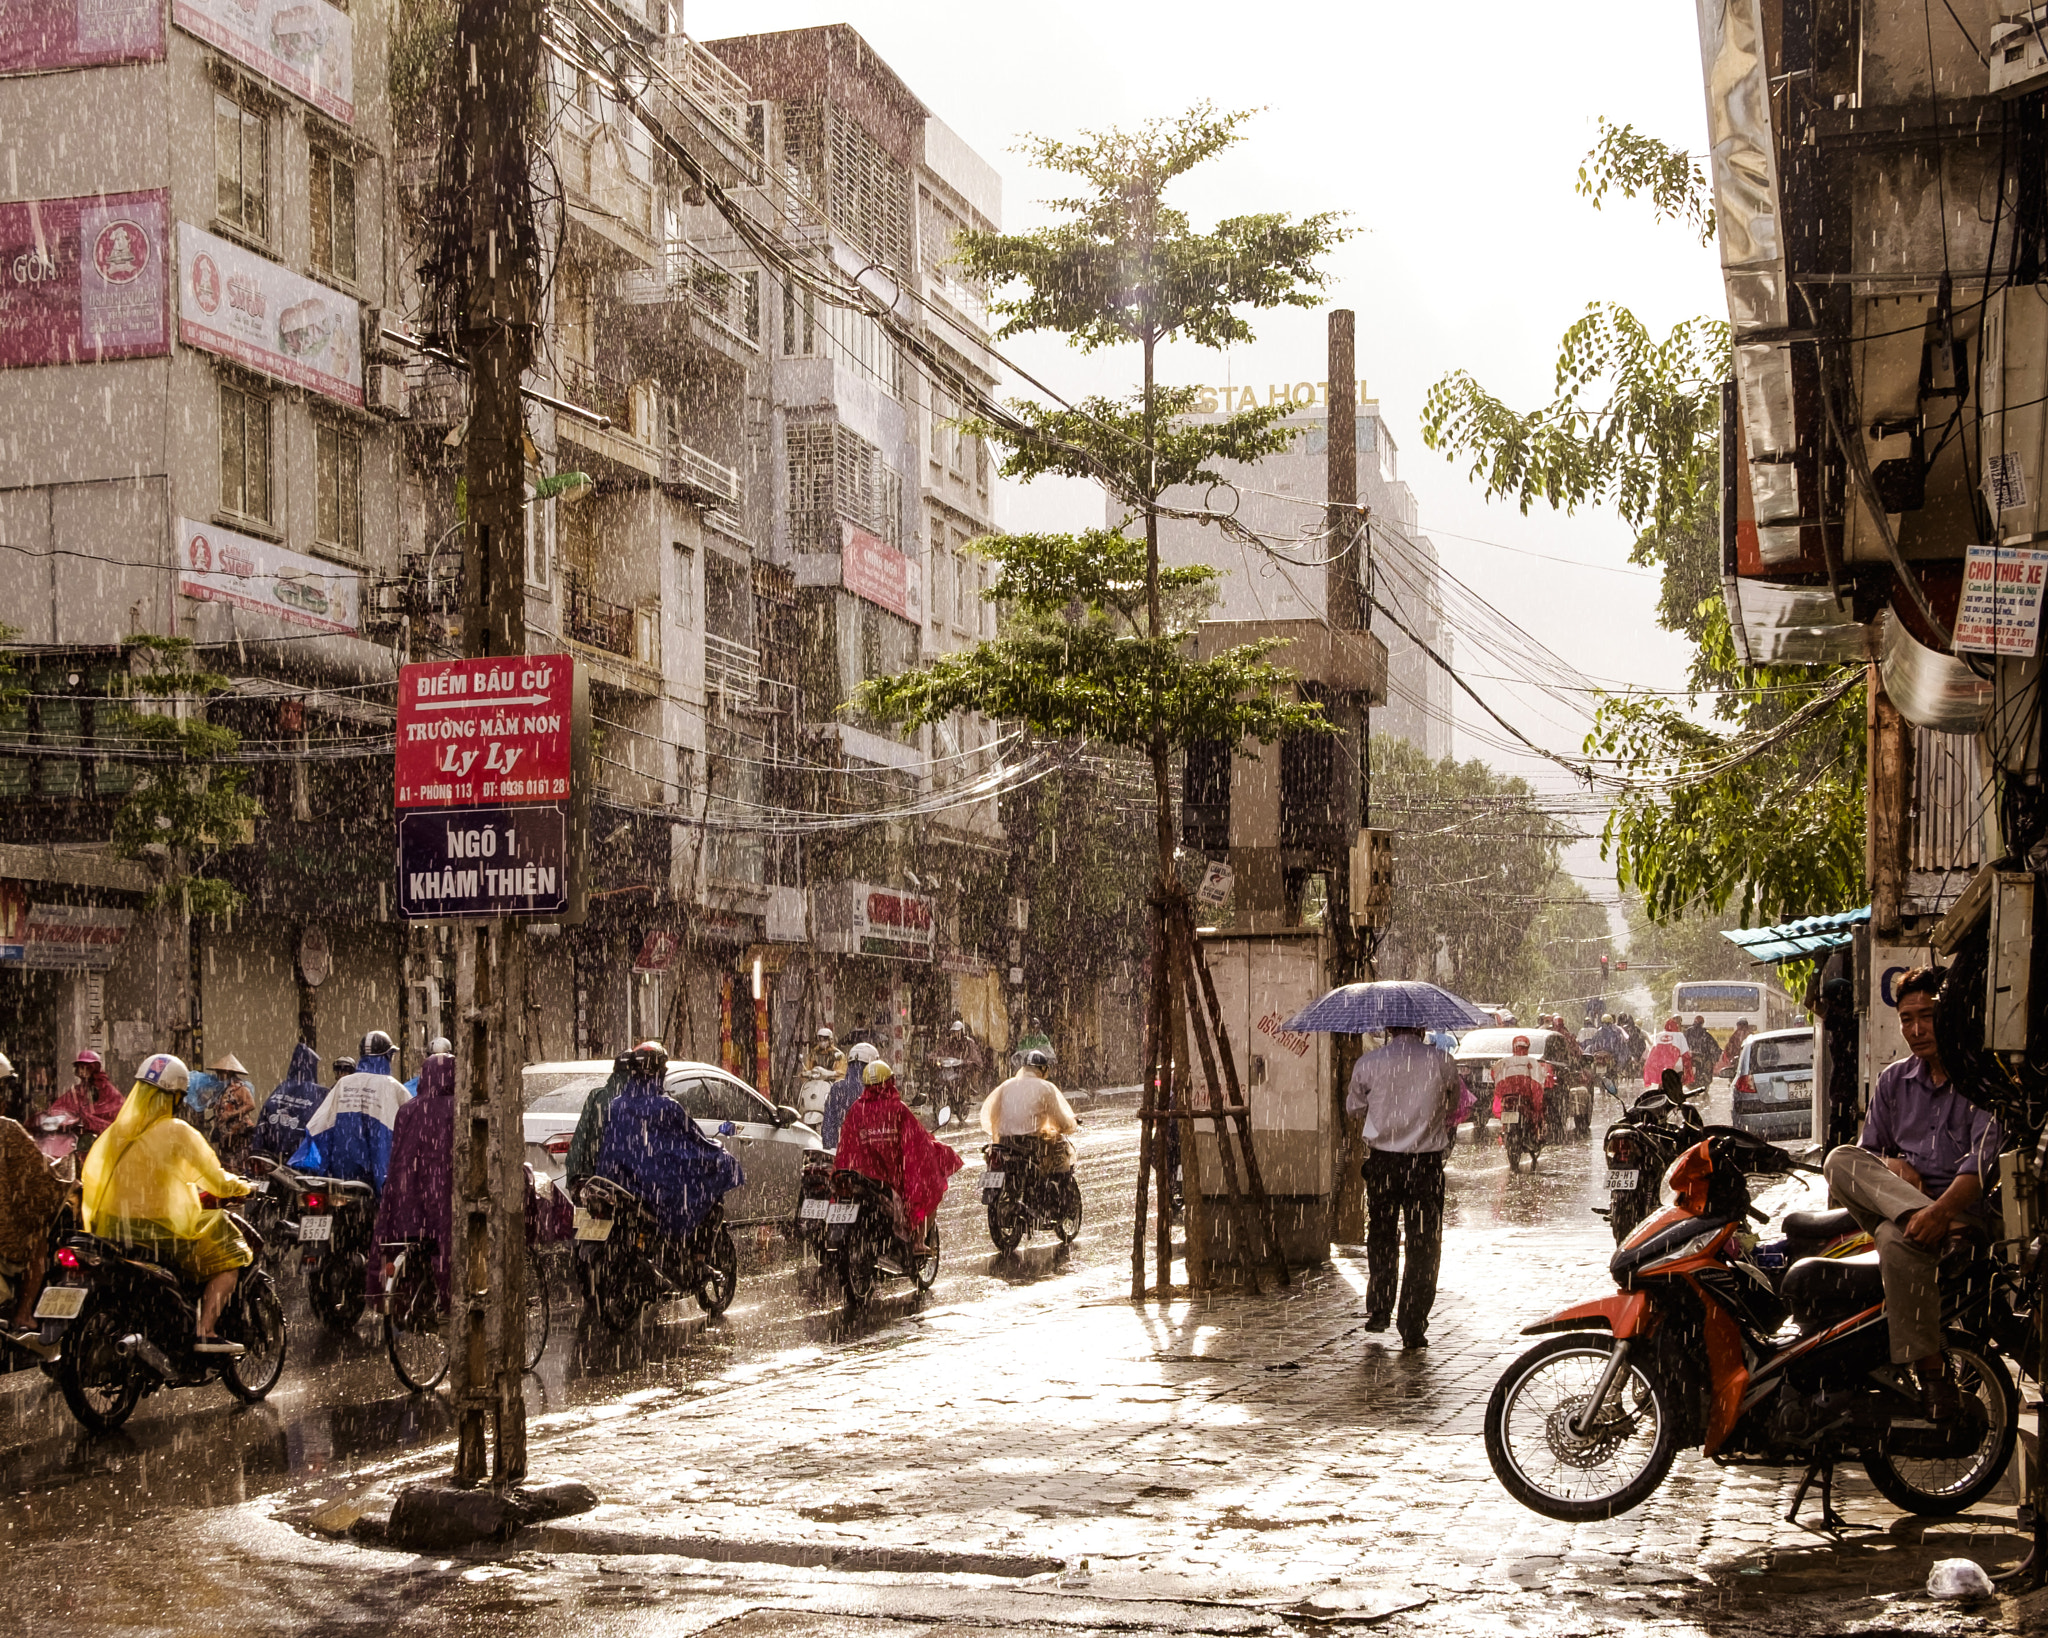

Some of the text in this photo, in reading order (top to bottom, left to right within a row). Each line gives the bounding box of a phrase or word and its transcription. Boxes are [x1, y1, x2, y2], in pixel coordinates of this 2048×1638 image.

[1269, 380, 1379, 410] HOTL
[1968, 561, 2043, 584] CHO THUÊ XE
[417, 662, 553, 697] ĐIỂM BẦU CỬ
[406, 709, 561, 741] TRƯỜNG MẦM NON
[440, 742, 524, 777] Ly Ly
[400, 787, 410, 801] A1
[420, 782, 452, 800] PHÒNG
[455, 783, 472, 799] 113
[483, 782, 498, 797] ĐT:
[553, 778, 565, 794] 28
[447, 825, 516, 859] NGÕ 1
[410, 862, 556, 900] KHÂM THIÊN
[1606, 1180, 1635, 1188] 306.56
[1610, 1171, 1633, 1179] 29-H1
